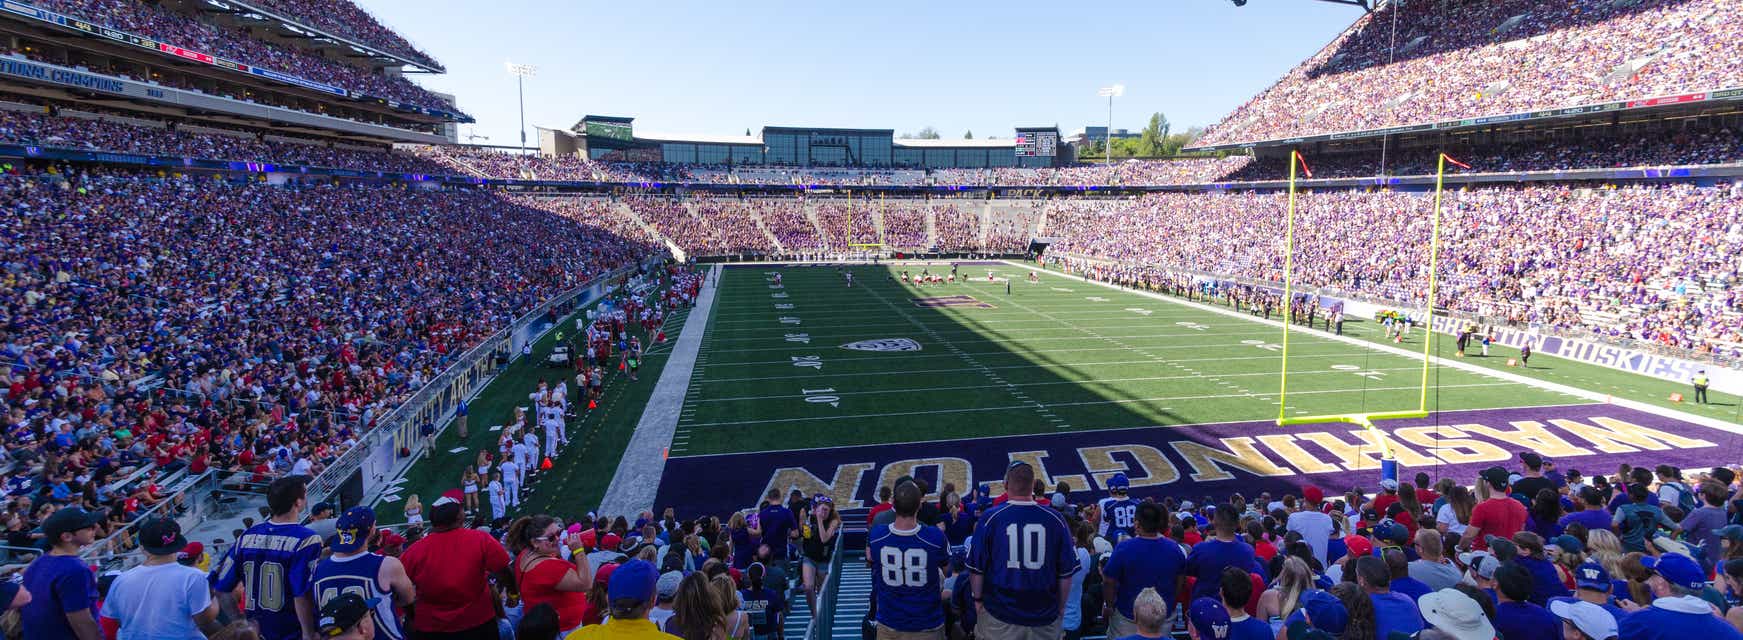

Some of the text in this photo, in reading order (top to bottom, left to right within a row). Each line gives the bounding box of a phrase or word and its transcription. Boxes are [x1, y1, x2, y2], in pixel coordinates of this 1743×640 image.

[52, 69, 124, 93] CHAMPIONS
[1007, 188, 1043, 198] PACK
[1559, 338, 1693, 381] HUSKIES
[450, 367, 472, 409] ARE
[802, 387, 840, 404] 10
[742, 416, 1718, 513] WASHINGTON
[1114, 505, 1137, 528] 88
[240, 533, 300, 553] WASHINGTON
[1006, 523, 1047, 570] 10
[880, 546, 928, 588] 88
[1582, 568, 1601, 580] W
[243, 560, 285, 613] 10
[1211, 624, 1229, 639] W
